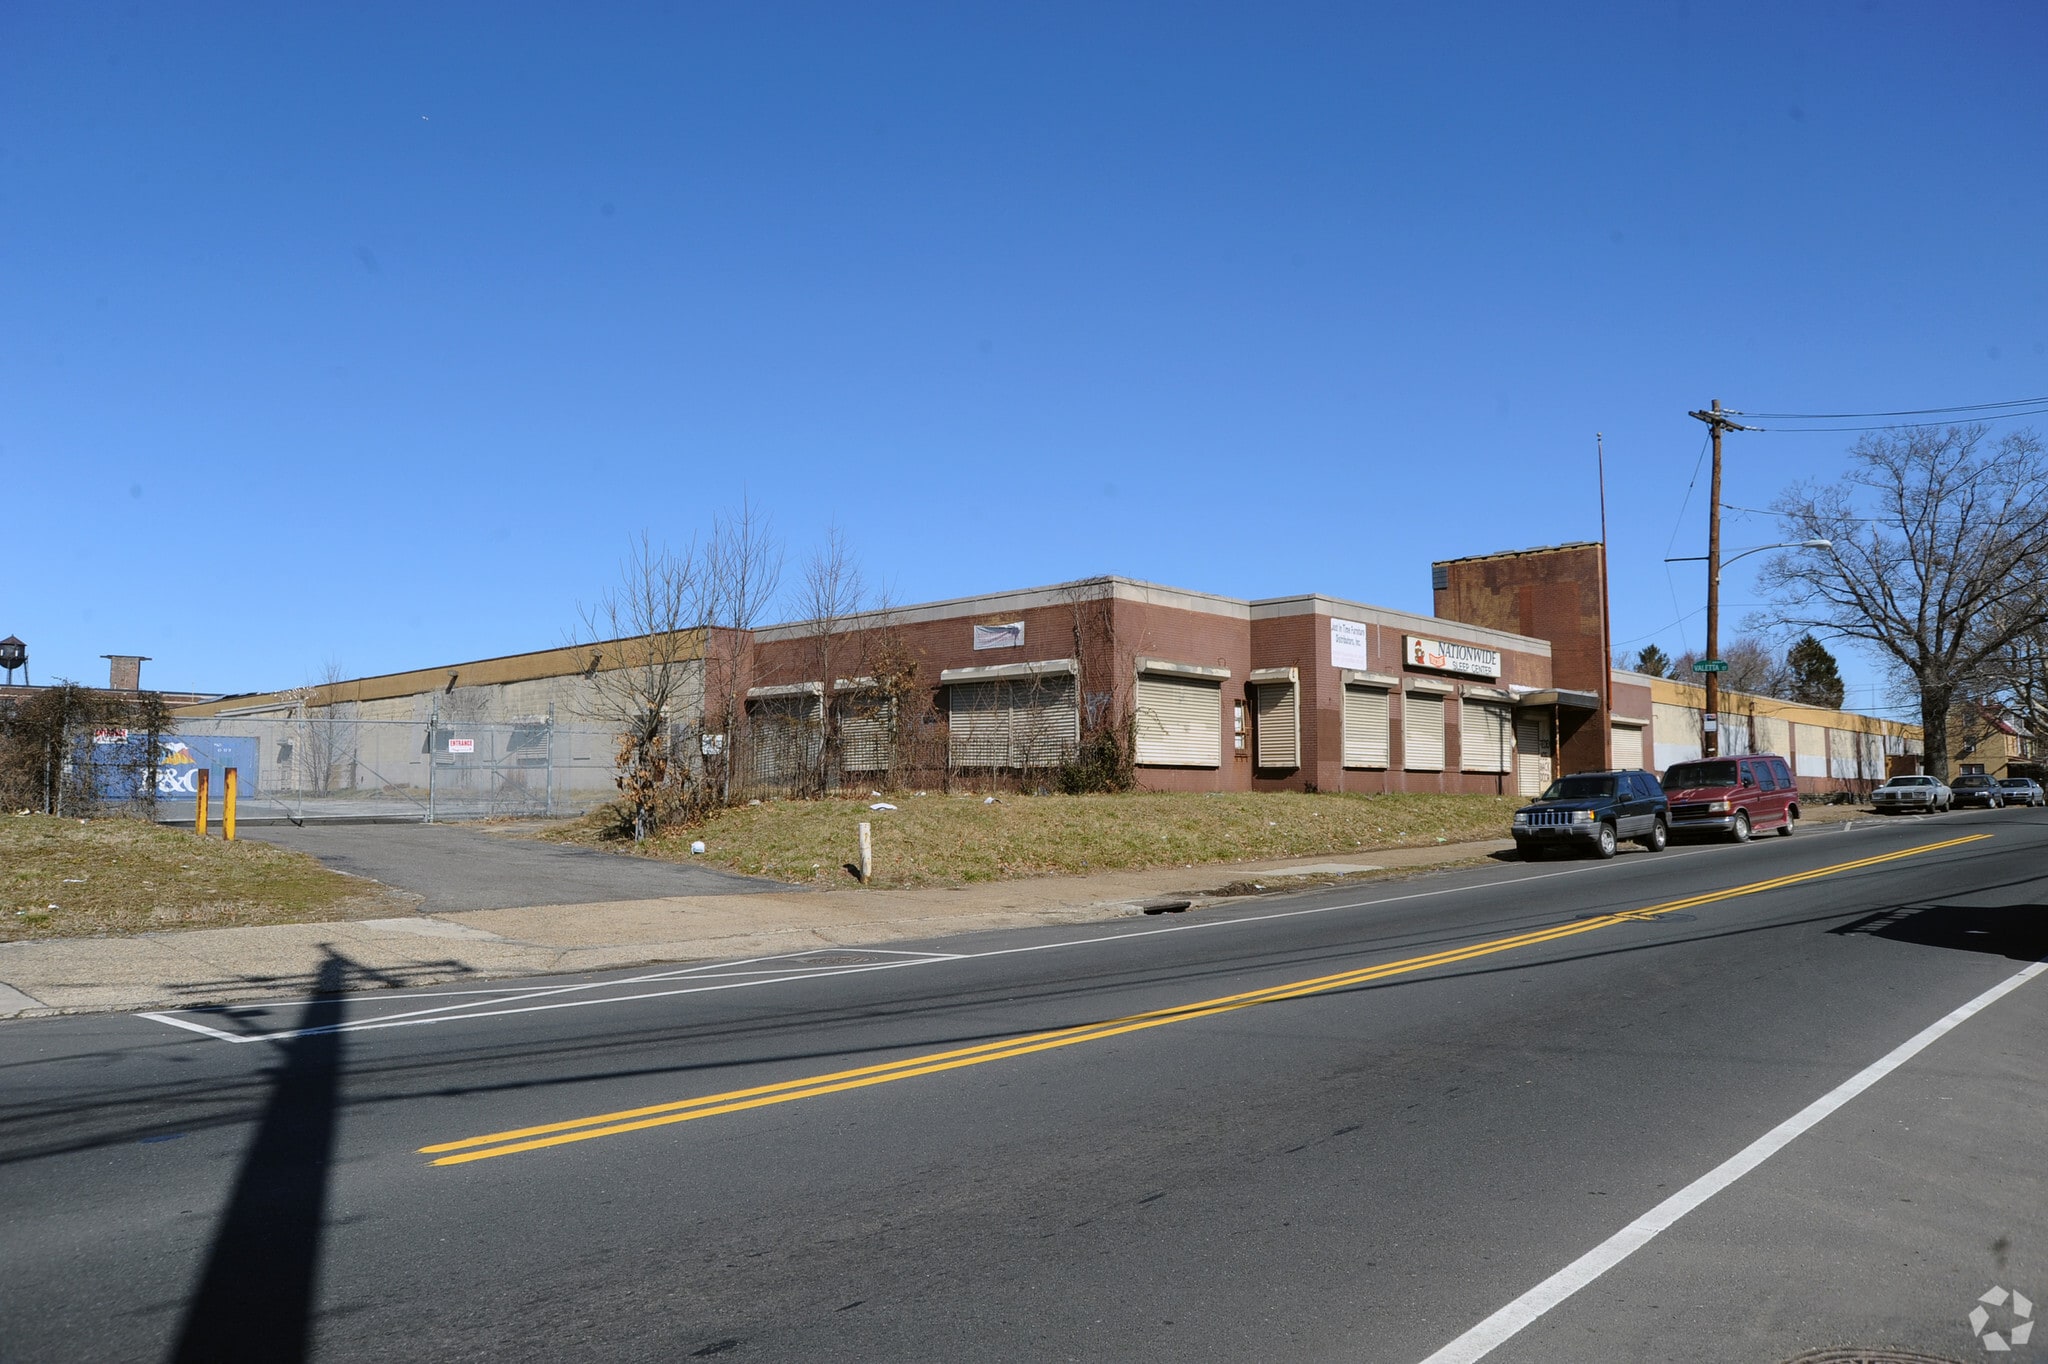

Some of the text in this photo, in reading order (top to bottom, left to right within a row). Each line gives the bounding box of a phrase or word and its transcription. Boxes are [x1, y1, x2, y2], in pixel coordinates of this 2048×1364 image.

[1438, 641, 1497, 665] NATIONWIDE
[1452, 660, 1470, 672] SLEEP
[1471, 663, 1492, 675] CENTER
